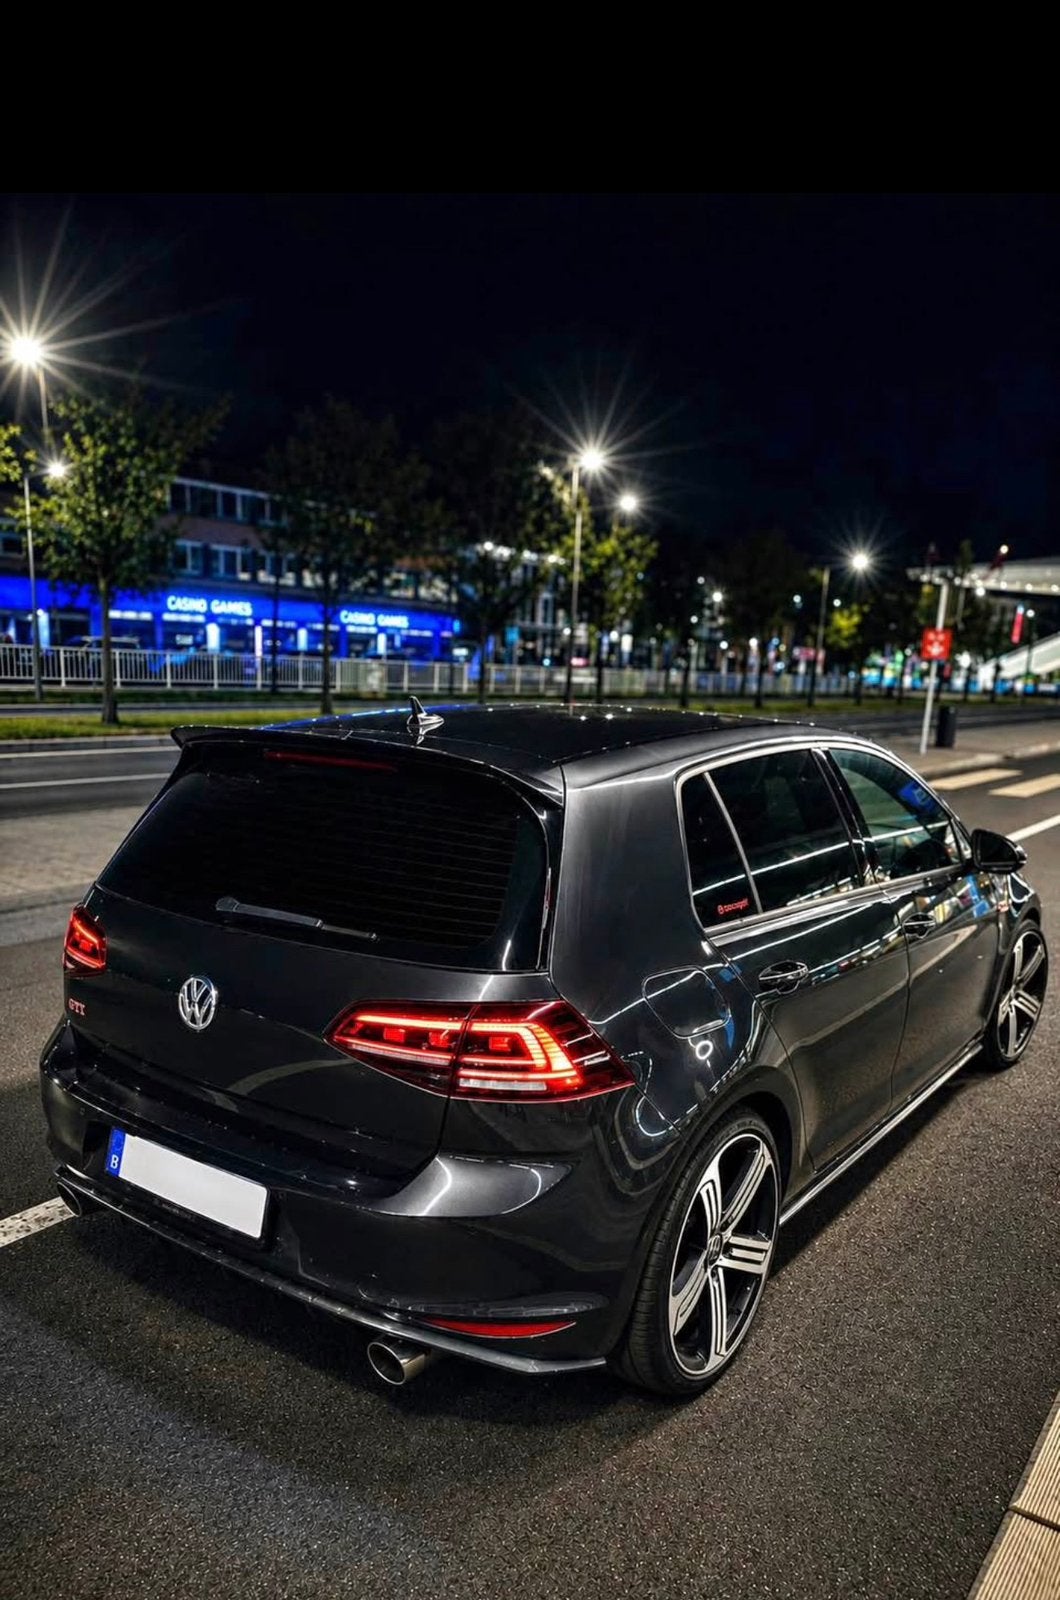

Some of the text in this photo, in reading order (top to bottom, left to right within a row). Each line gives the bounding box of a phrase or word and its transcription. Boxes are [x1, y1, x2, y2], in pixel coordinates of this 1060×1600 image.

[167, 595, 253, 616] CASINO GAMES
[340, 610, 409, 629] CASINO GAMES
[68, 998, 86, 1016] GTI
[110, 1154, 119, 1169] B
